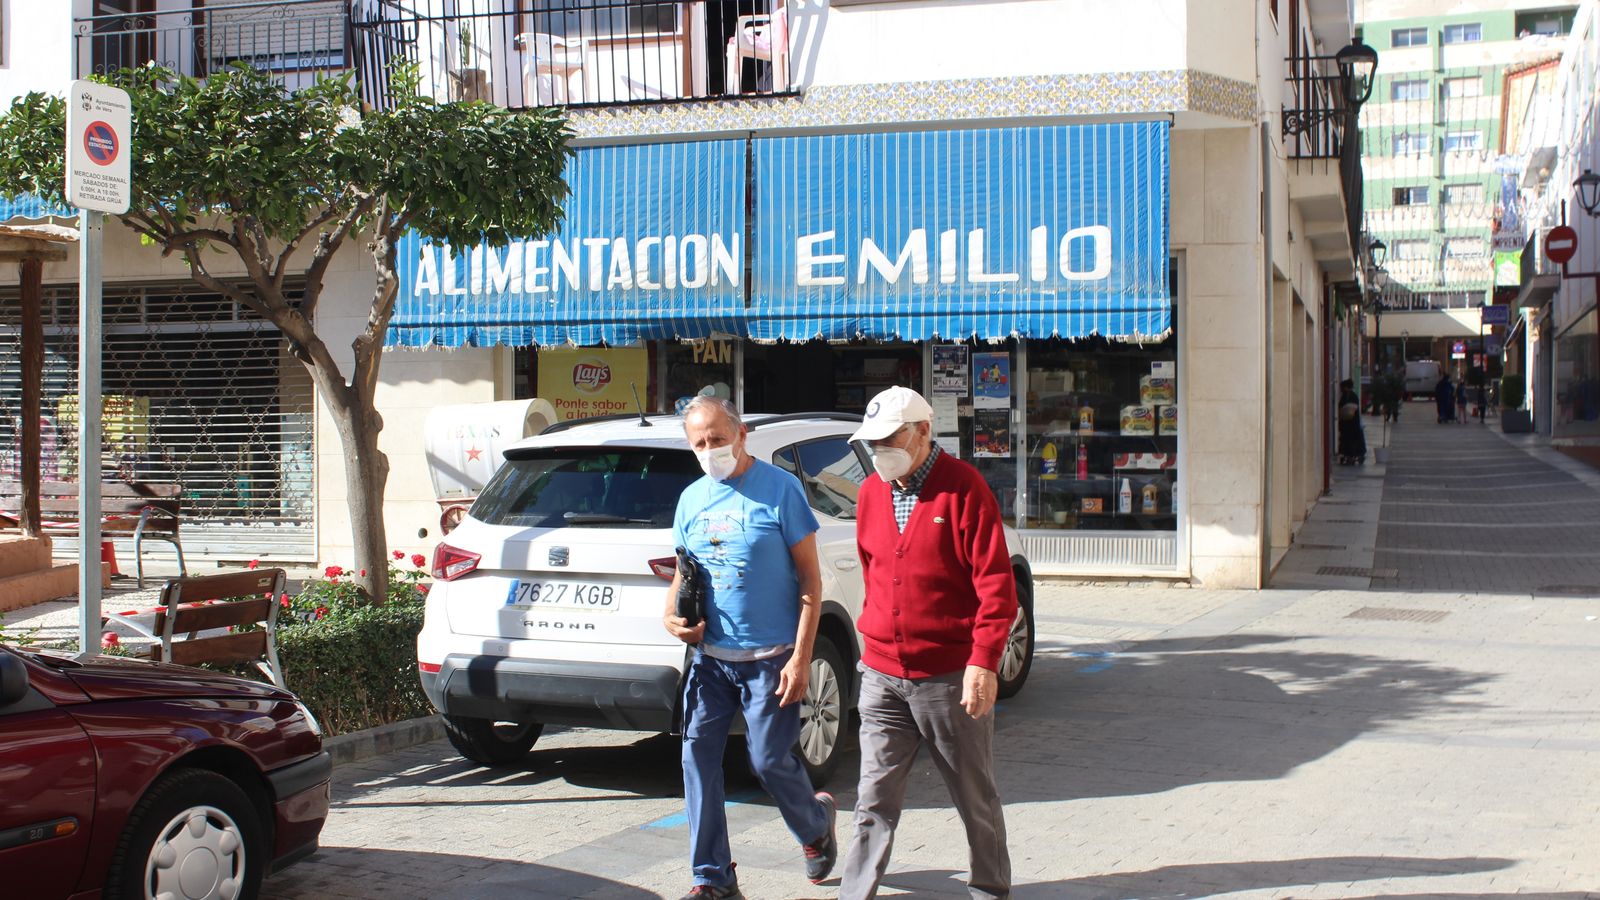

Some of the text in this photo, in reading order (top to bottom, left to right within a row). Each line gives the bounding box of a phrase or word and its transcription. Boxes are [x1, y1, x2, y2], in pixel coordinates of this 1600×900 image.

[74, 170, 127, 185] MERCADO SEMANAL
[79, 192, 106, 202] RETIRADA
[797, 225, 1112, 286] EMILIO
[414, 233, 739, 297] ALIMENTACION
[692, 338, 731, 364] PAN
[555, 398, 628, 410] Ponle sabor
[566, 411, 574, 420] a
[576, 410, 588, 419] la
[518, 583, 614, 606] 7627 KGB
[523, 621, 595, 630] ARONA
